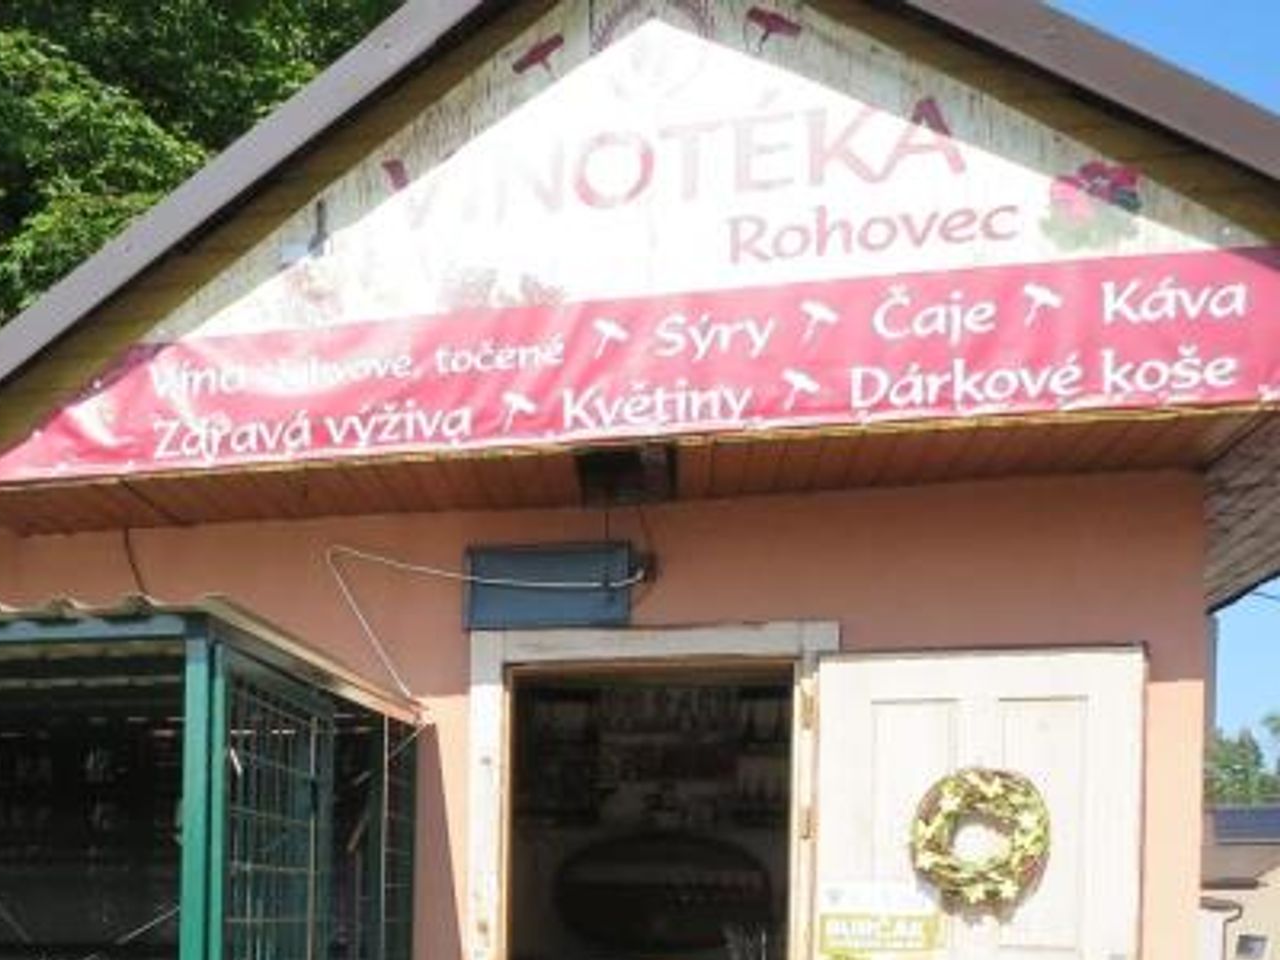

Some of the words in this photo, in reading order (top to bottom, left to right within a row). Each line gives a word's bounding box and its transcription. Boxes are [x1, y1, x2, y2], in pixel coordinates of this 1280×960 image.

[381, 88, 968, 229] VINOTÉKA
[728, 203, 1019, 265] Rohovec
[435, 332, 565, 374] točené
[654, 311, 776, 362] Sýry
[872, 285, 998, 346] Čaje
[1101, 279, 1248, 323] Káva
[152, 409, 312, 460] Zdravá
[324, 398, 472, 448] výživa
[562, 377, 753, 431] Květiny
[850, 353, 1084, 412] Dárkové
[1101, 343, 1240, 394] koše
